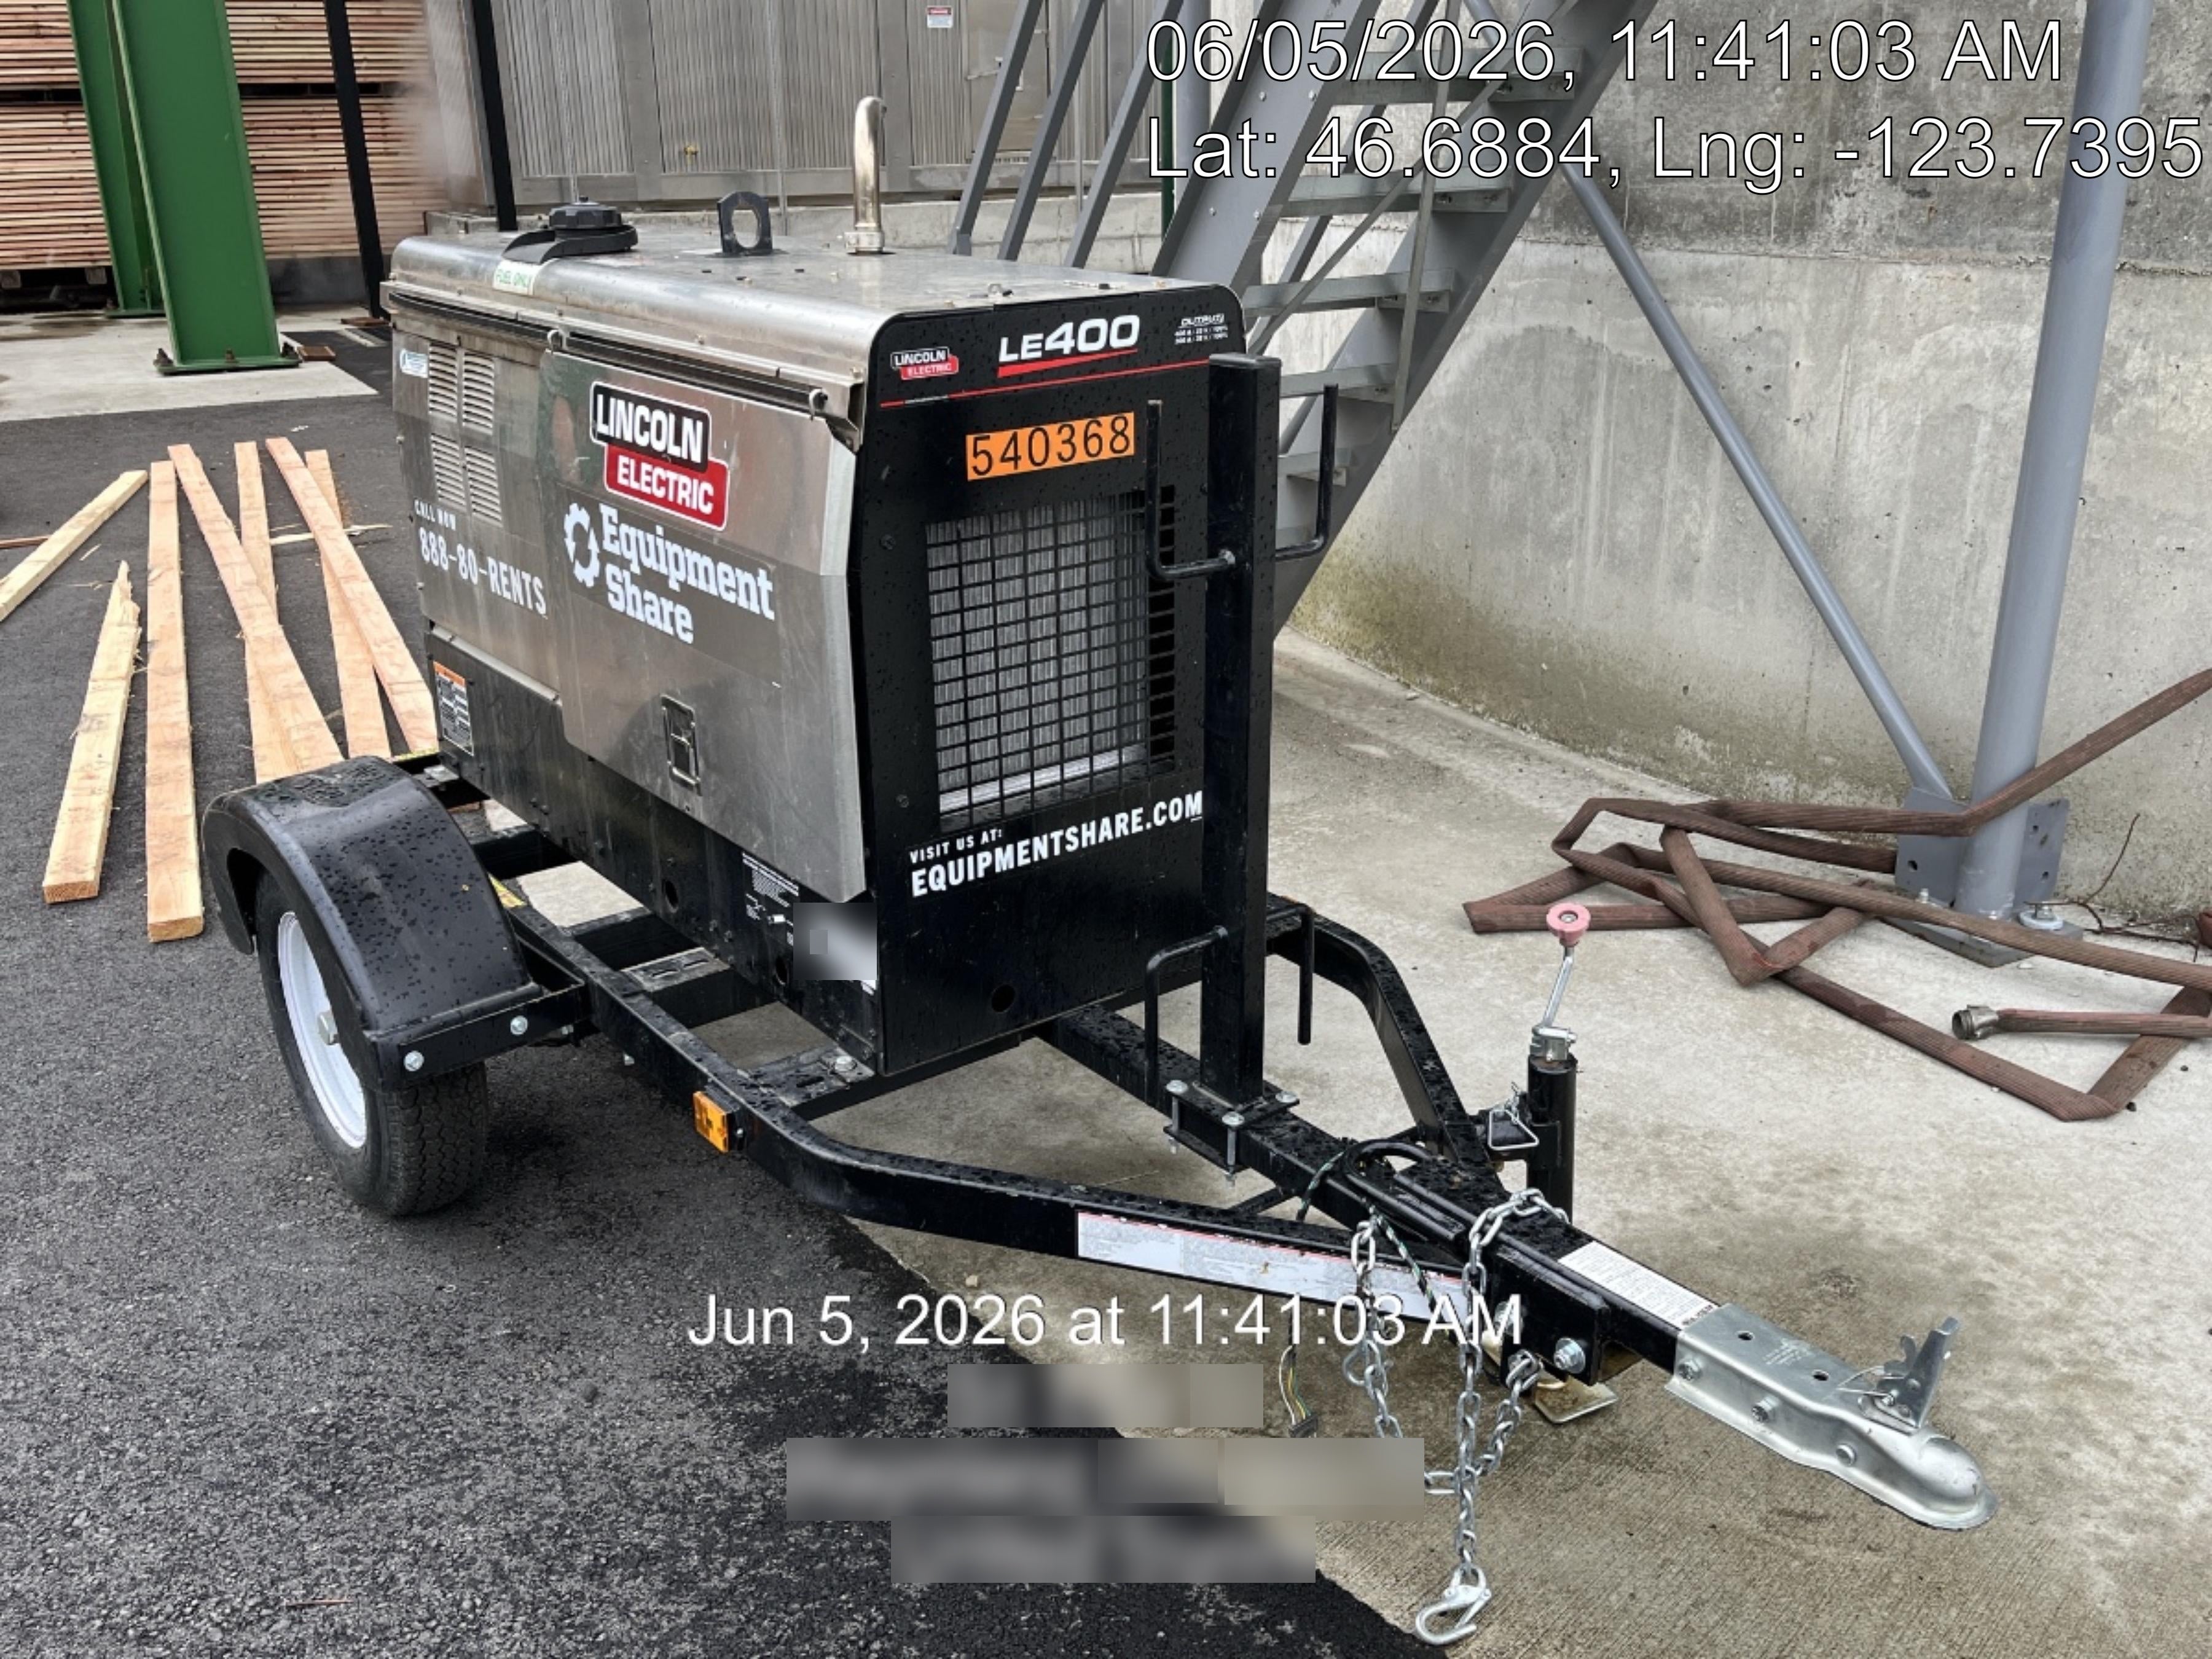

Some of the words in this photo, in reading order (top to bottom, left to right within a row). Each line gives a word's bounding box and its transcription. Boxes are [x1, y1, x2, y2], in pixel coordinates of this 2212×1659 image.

[895, 350, 947, 367] LINCOLN
[907, 363, 952, 376] ELECTRIC
[998, 315, 1140, 363] LE400
[597, 393, 704, 463] LINCOLN
[971, 415, 1130, 476] 540368
[617, 455, 714, 514] ELECTRIC
[419, 526, 547, 616] 888-80-RENTS
[598, 502, 775, 621] Equipment
[605, 563, 694, 645] Share
[909, 841, 950, 864] VISIT
[956, 835, 975, 851] US
[911, 789, 1203, 898] EQUIPMENTSHARE.COM
